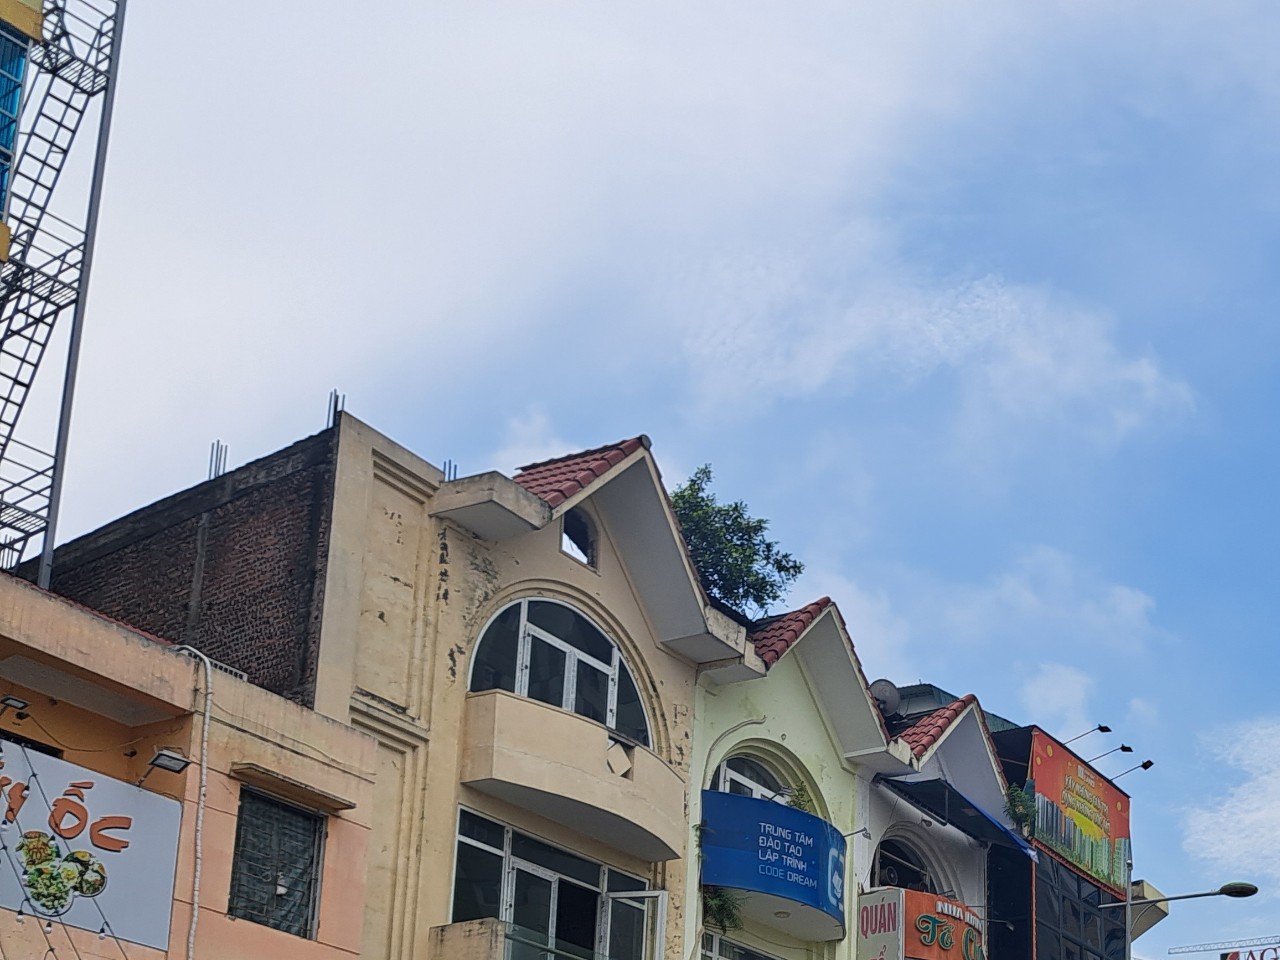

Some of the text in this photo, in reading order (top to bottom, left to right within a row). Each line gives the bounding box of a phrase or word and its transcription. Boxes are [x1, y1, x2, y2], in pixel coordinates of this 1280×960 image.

[758, 822, 814, 848] TRUNG TÂM
[758, 836, 781, 851] ĐÀO
[758, 849, 808, 873] LẬP TRÌNH
[758, 864, 818, 890] CODE DREAM
[860, 897, 897, 940] QUÁN
